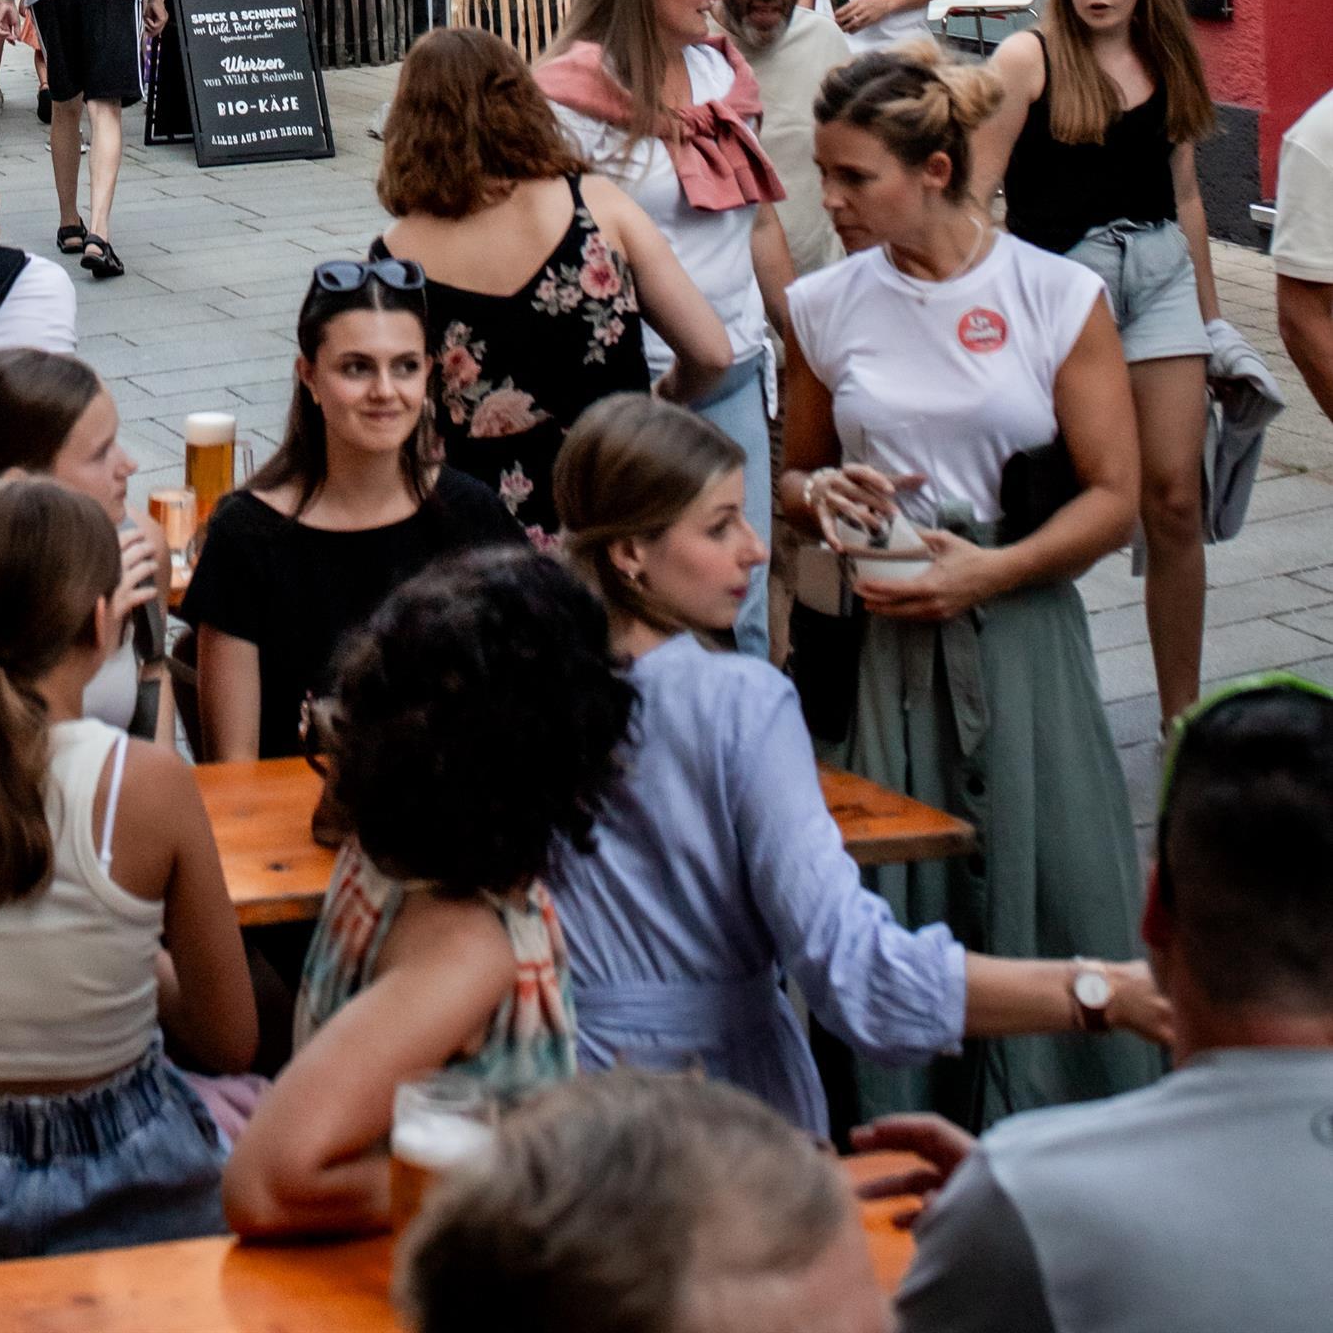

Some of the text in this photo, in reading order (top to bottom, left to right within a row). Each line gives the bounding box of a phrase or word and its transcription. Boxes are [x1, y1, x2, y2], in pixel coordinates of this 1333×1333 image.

[191, 12, 227, 25] SPECK
[240, 7, 297, 21] SCHINKEN
[203, 69, 304, 87] von Wild & Schwein
[216, 94, 300, 117] BIO-KÄSE
[211, 125, 314, 146] ALLES AUS DER REGION
